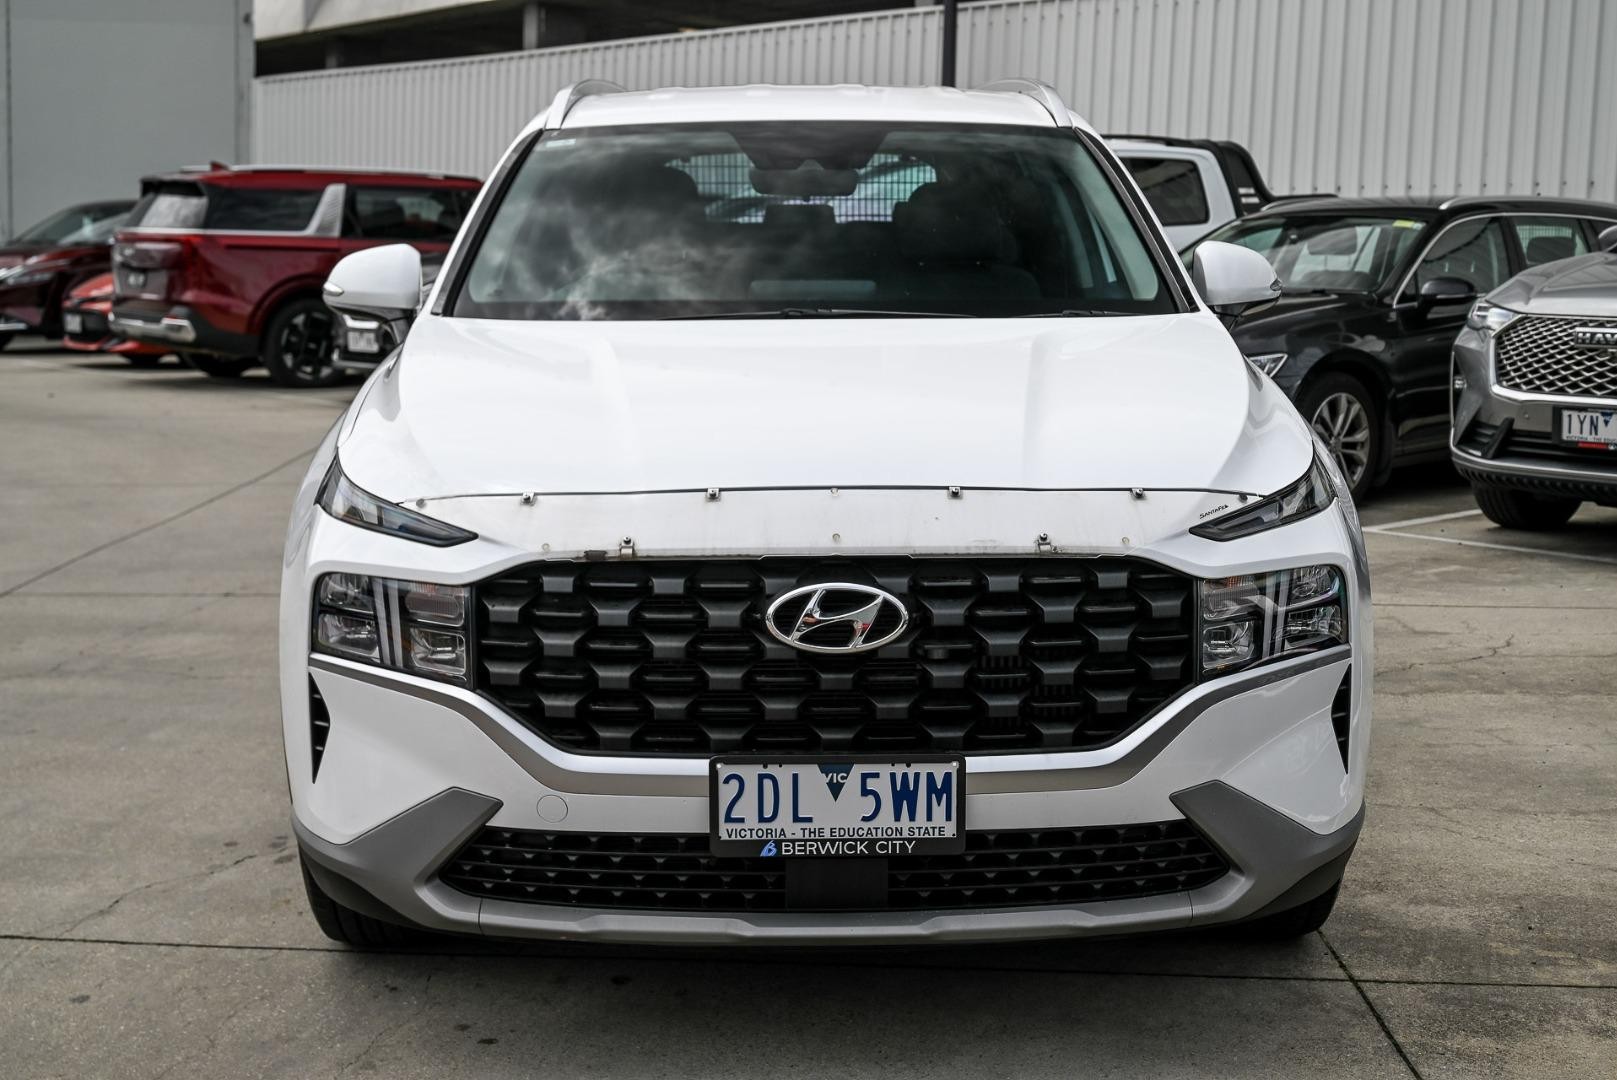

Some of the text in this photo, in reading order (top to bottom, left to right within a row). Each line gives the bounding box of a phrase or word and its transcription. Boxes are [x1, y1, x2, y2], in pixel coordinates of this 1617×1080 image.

[1567, 414, 1599, 436] 1YN
[823, 772, 848, 784] VIC
[722, 771, 953, 824] 2DL 5WM
[726, 828, 787, 839] VICTORIA
[800, 827, 825, 838] THE
[829, 827, 903, 838] EDUCATION
[907, 826, 946, 837] STATE
[781, 842, 869, 855] BERWICK
[875, 841, 917, 854] CITY
